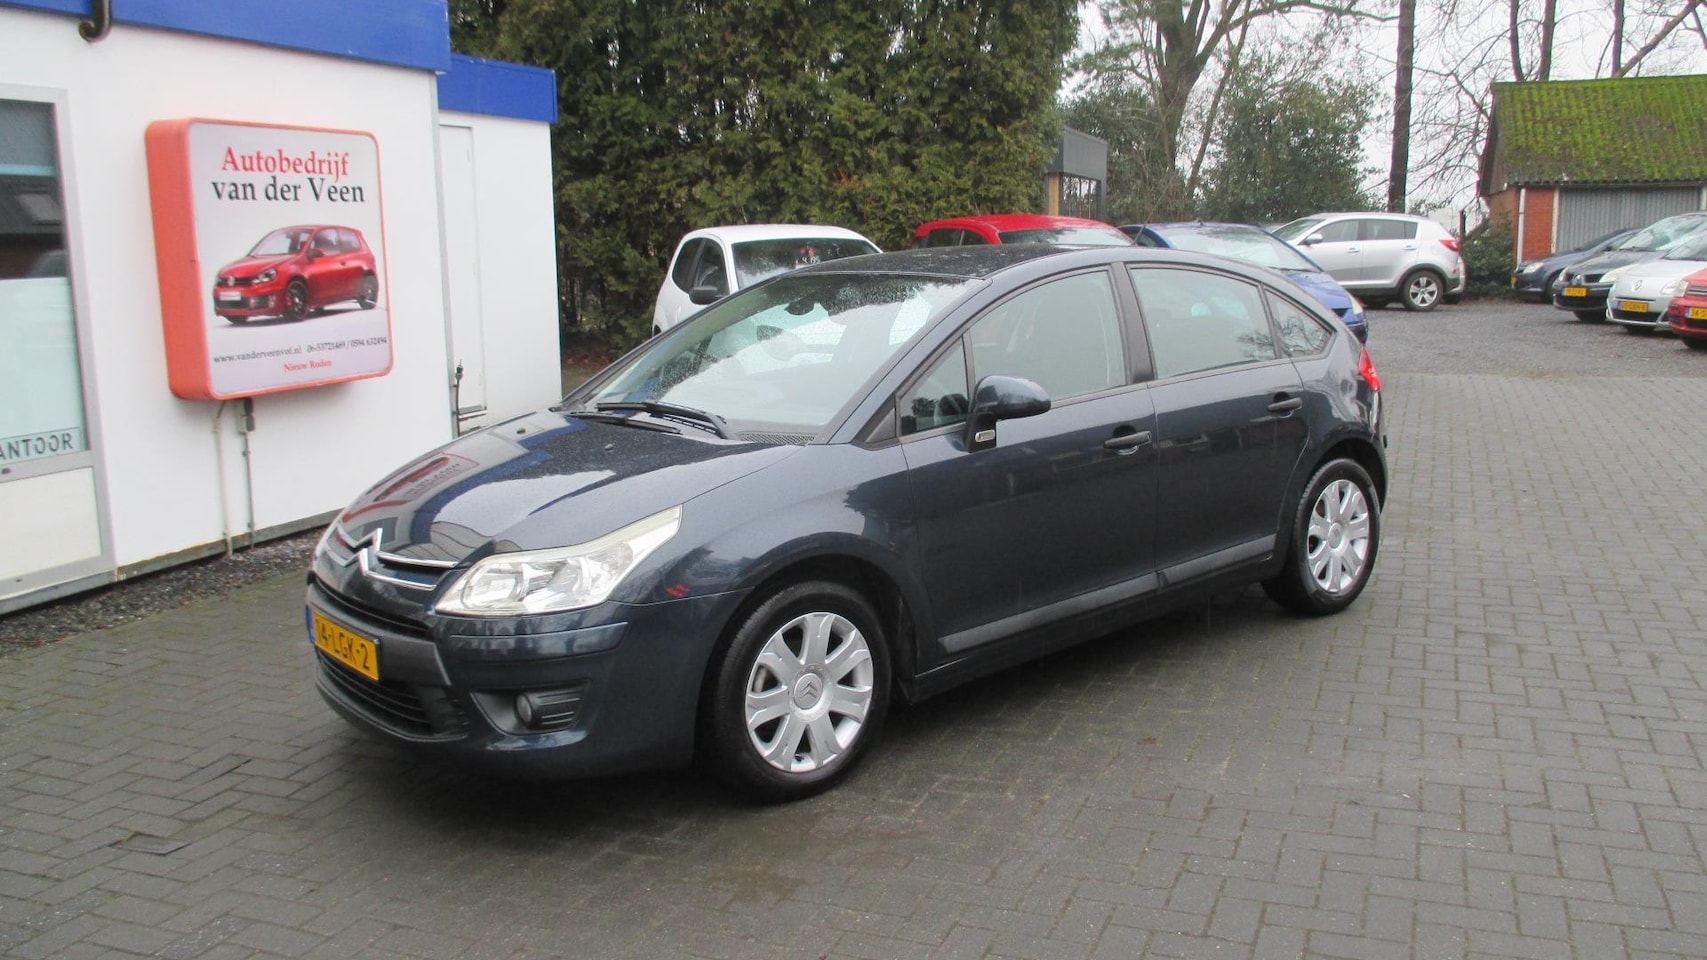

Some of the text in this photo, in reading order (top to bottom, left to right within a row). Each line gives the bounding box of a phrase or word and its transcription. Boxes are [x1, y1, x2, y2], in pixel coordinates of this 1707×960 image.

[221, 146, 349, 181] Autobedrijf
[212, 176, 365, 203] van der Veen
[283, 359, 332, 373] Nieuw Roden
